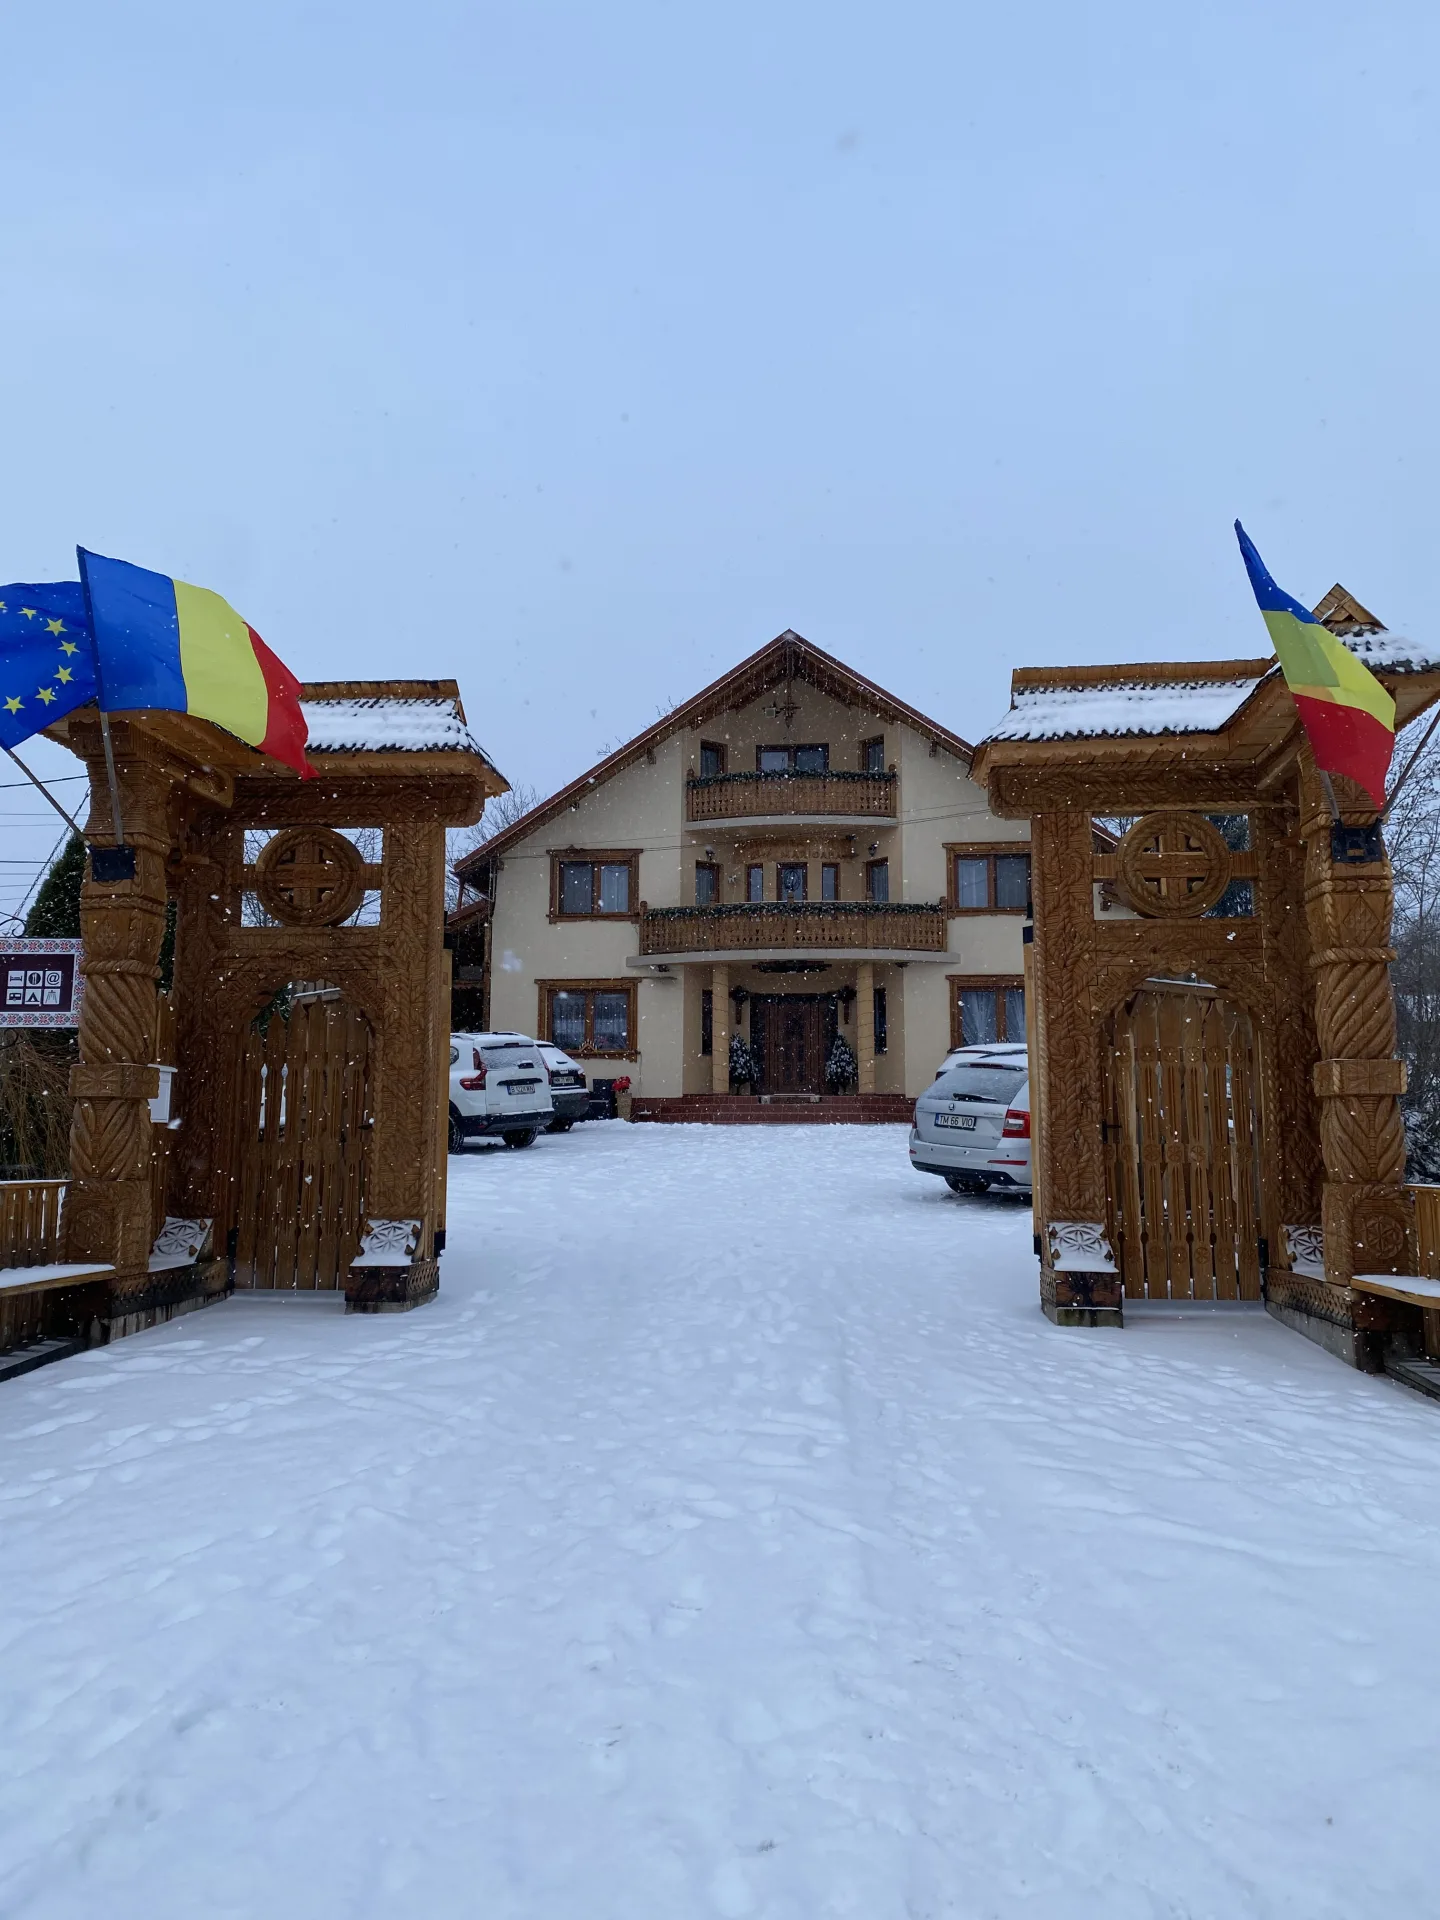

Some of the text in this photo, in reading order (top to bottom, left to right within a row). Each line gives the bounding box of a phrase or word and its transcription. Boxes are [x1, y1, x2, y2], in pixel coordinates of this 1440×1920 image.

[940, 1115, 973, 1127] TM 66 VIO
